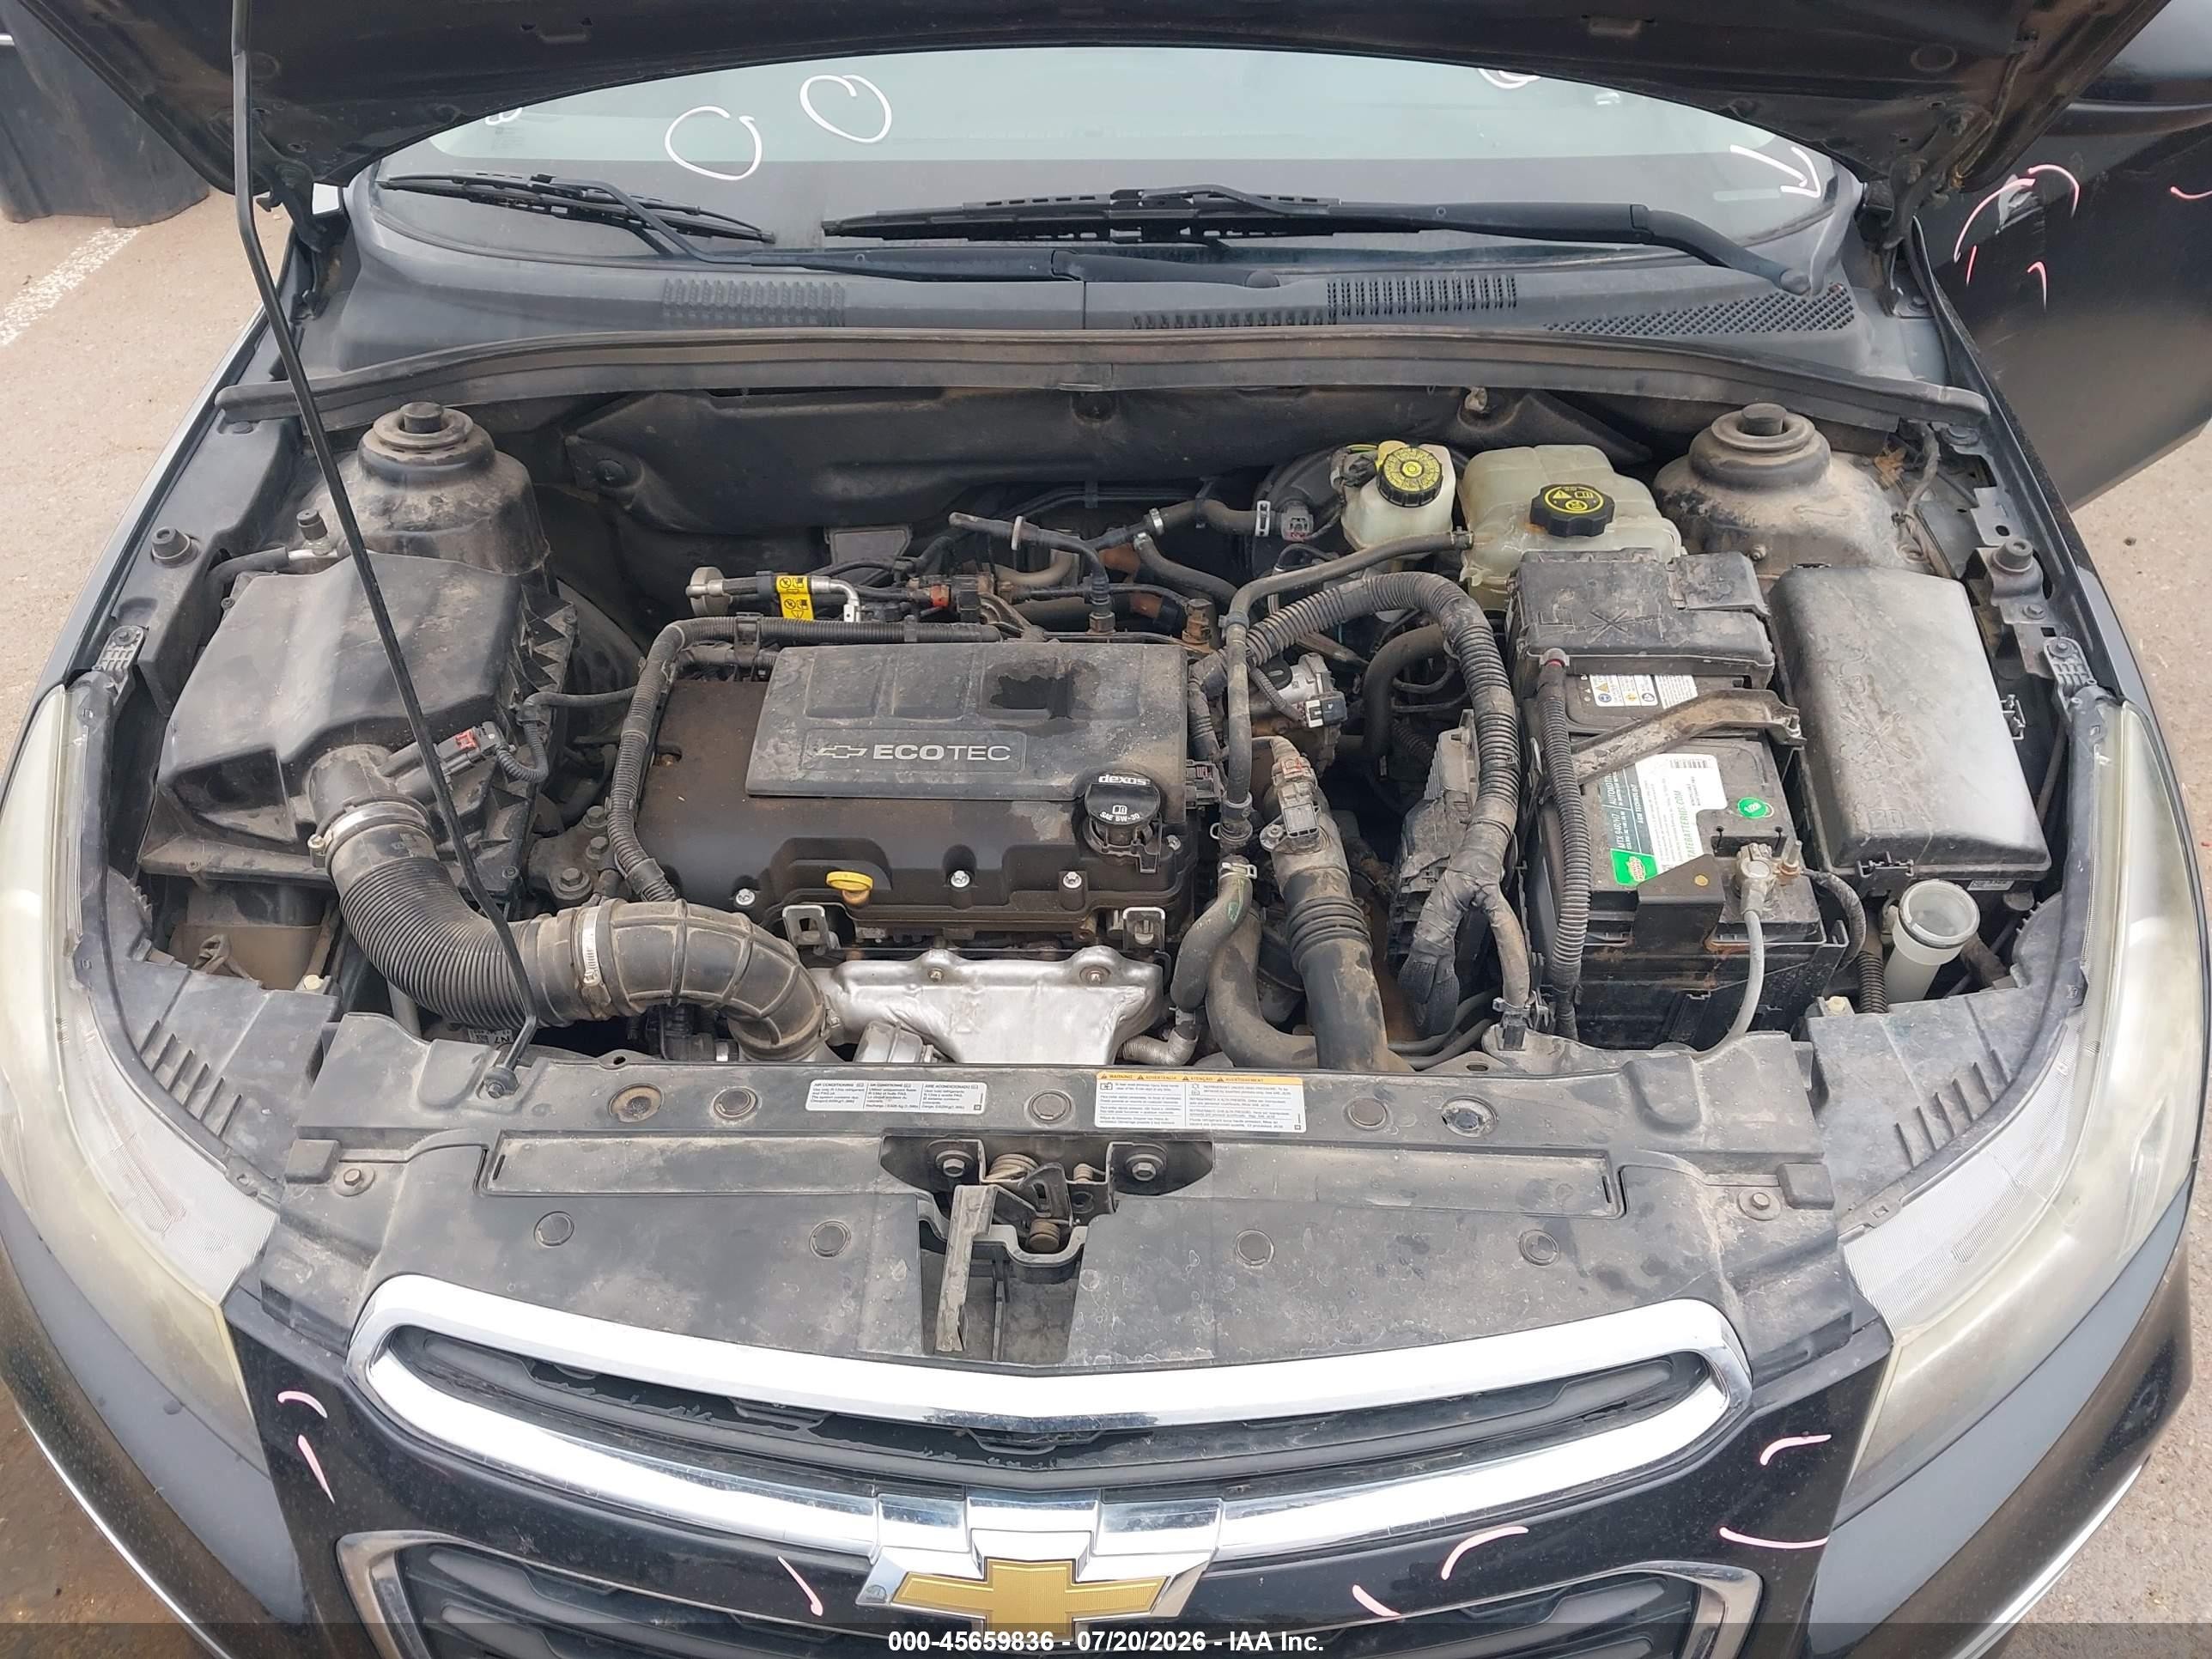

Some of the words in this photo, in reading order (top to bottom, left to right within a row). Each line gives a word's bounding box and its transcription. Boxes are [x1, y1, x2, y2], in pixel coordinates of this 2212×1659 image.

[872, 744, 1012, 762] ECOTEC
[1098, 775, 1147, 786] dexos
[1099, 811, 1114, 821] SAE
[1115, 812, 1140, 822] 5W-30
